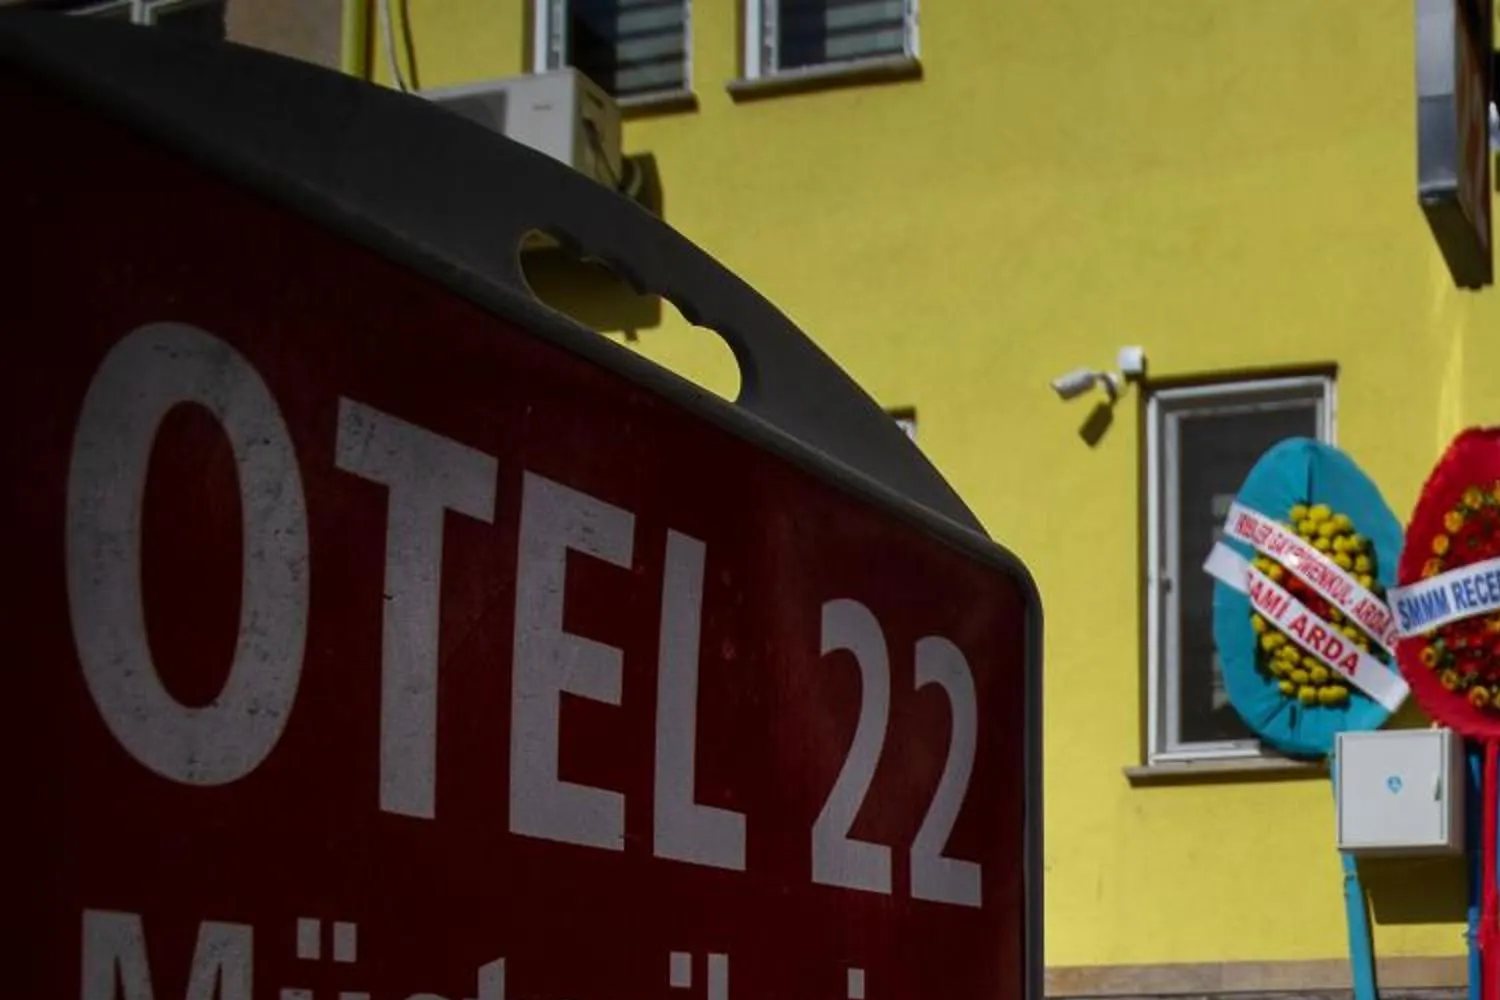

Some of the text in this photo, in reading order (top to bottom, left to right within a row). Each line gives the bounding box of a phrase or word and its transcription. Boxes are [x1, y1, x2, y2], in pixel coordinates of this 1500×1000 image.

[65, 321, 983, 908] OTEL 22
[1398, 584, 1452, 631] SMMM
[1289, 614, 1359, 676] ARDA
